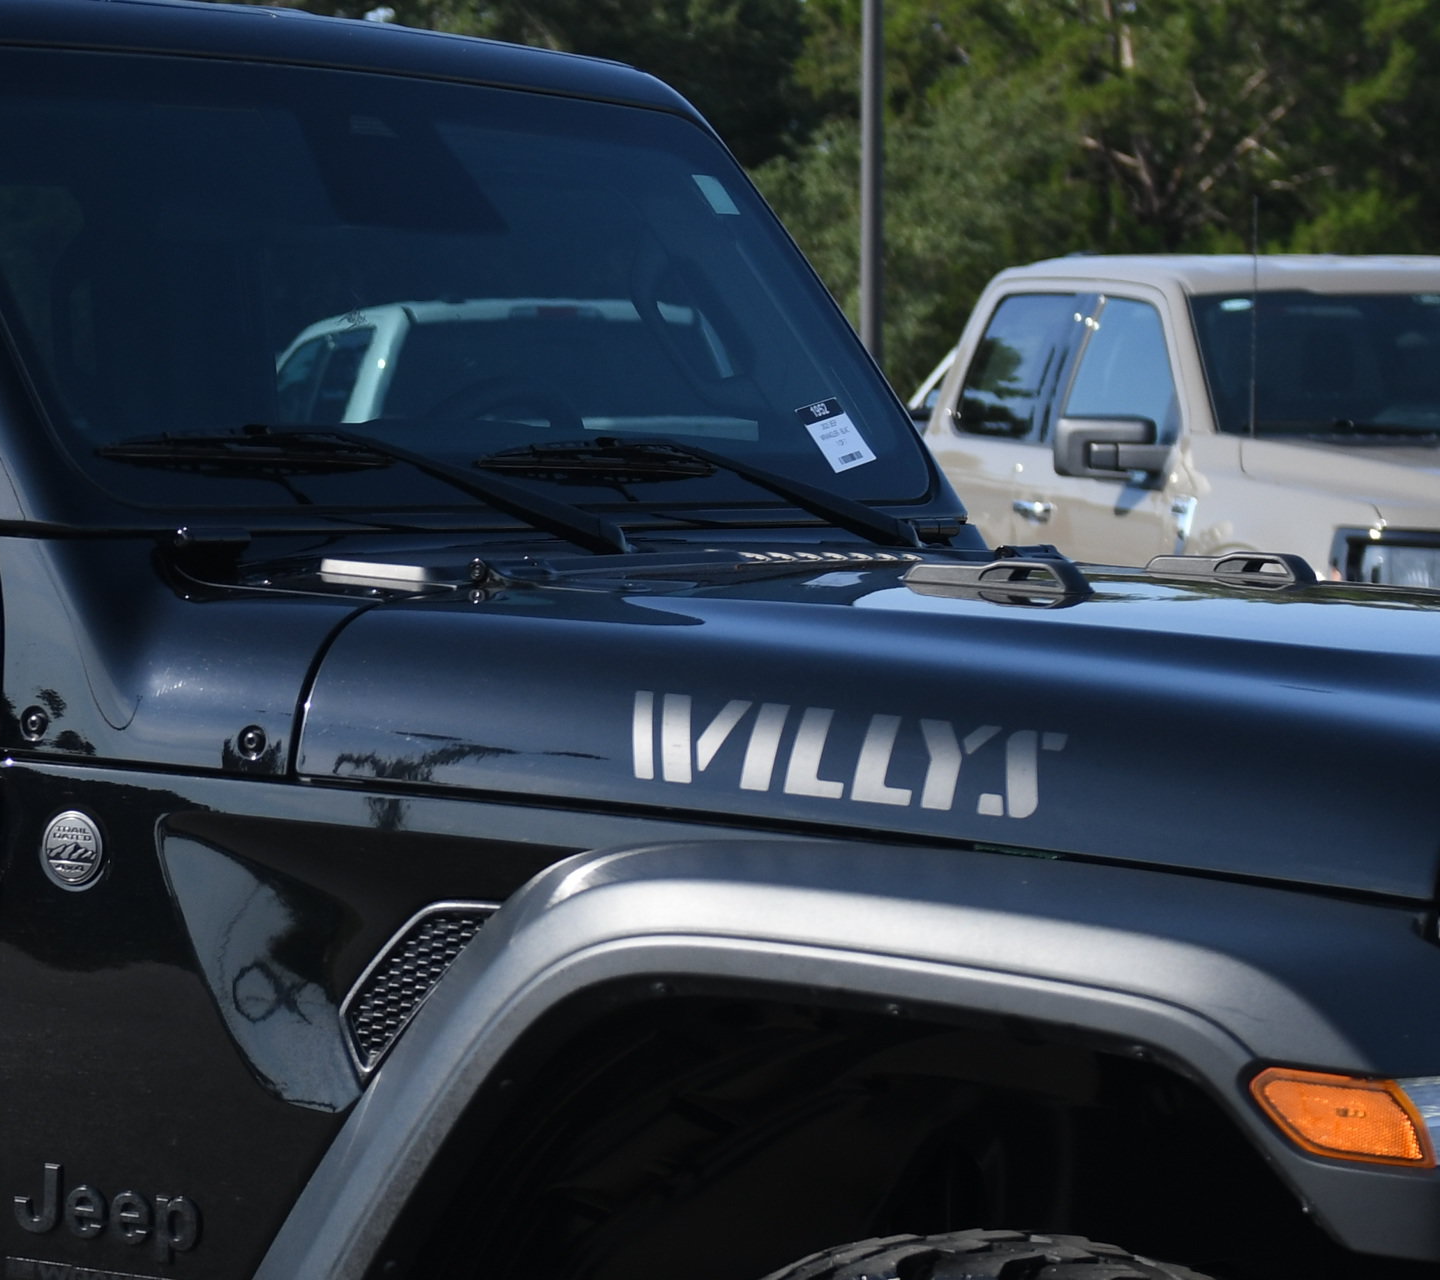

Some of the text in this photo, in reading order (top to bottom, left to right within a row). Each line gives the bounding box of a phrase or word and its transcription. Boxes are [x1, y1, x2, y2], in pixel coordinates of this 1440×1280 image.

[631, 690, 1069, 819] WILLYS
[52, 832, 92, 842] RATED
[55, 826, 90, 834] TRAIL
[13, 1162, 203, 1265] Jeep
